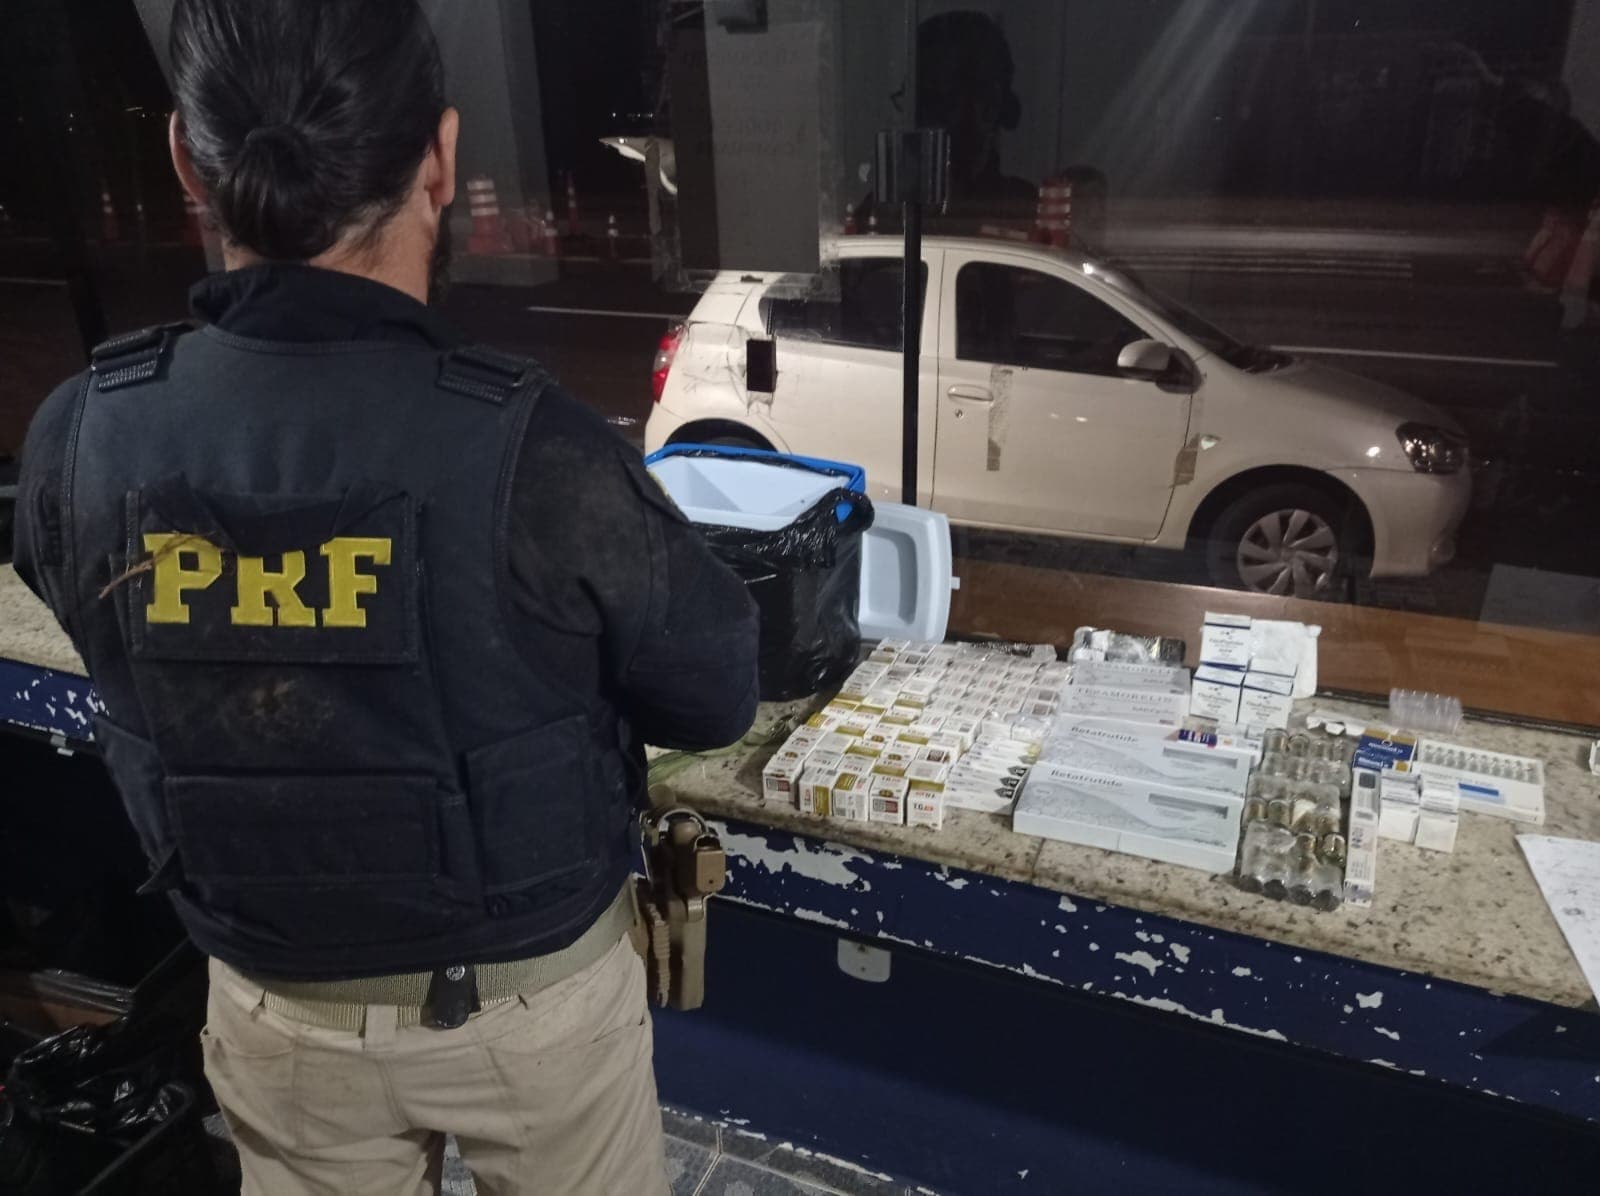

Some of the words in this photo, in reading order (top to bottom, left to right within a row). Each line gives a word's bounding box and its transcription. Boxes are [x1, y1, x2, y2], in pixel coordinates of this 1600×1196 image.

[143, 533, 392, 627] PRF
[1071, 726, 1137, 743] Retatrutide
[1051, 769, 1122, 787] Retatrutide
